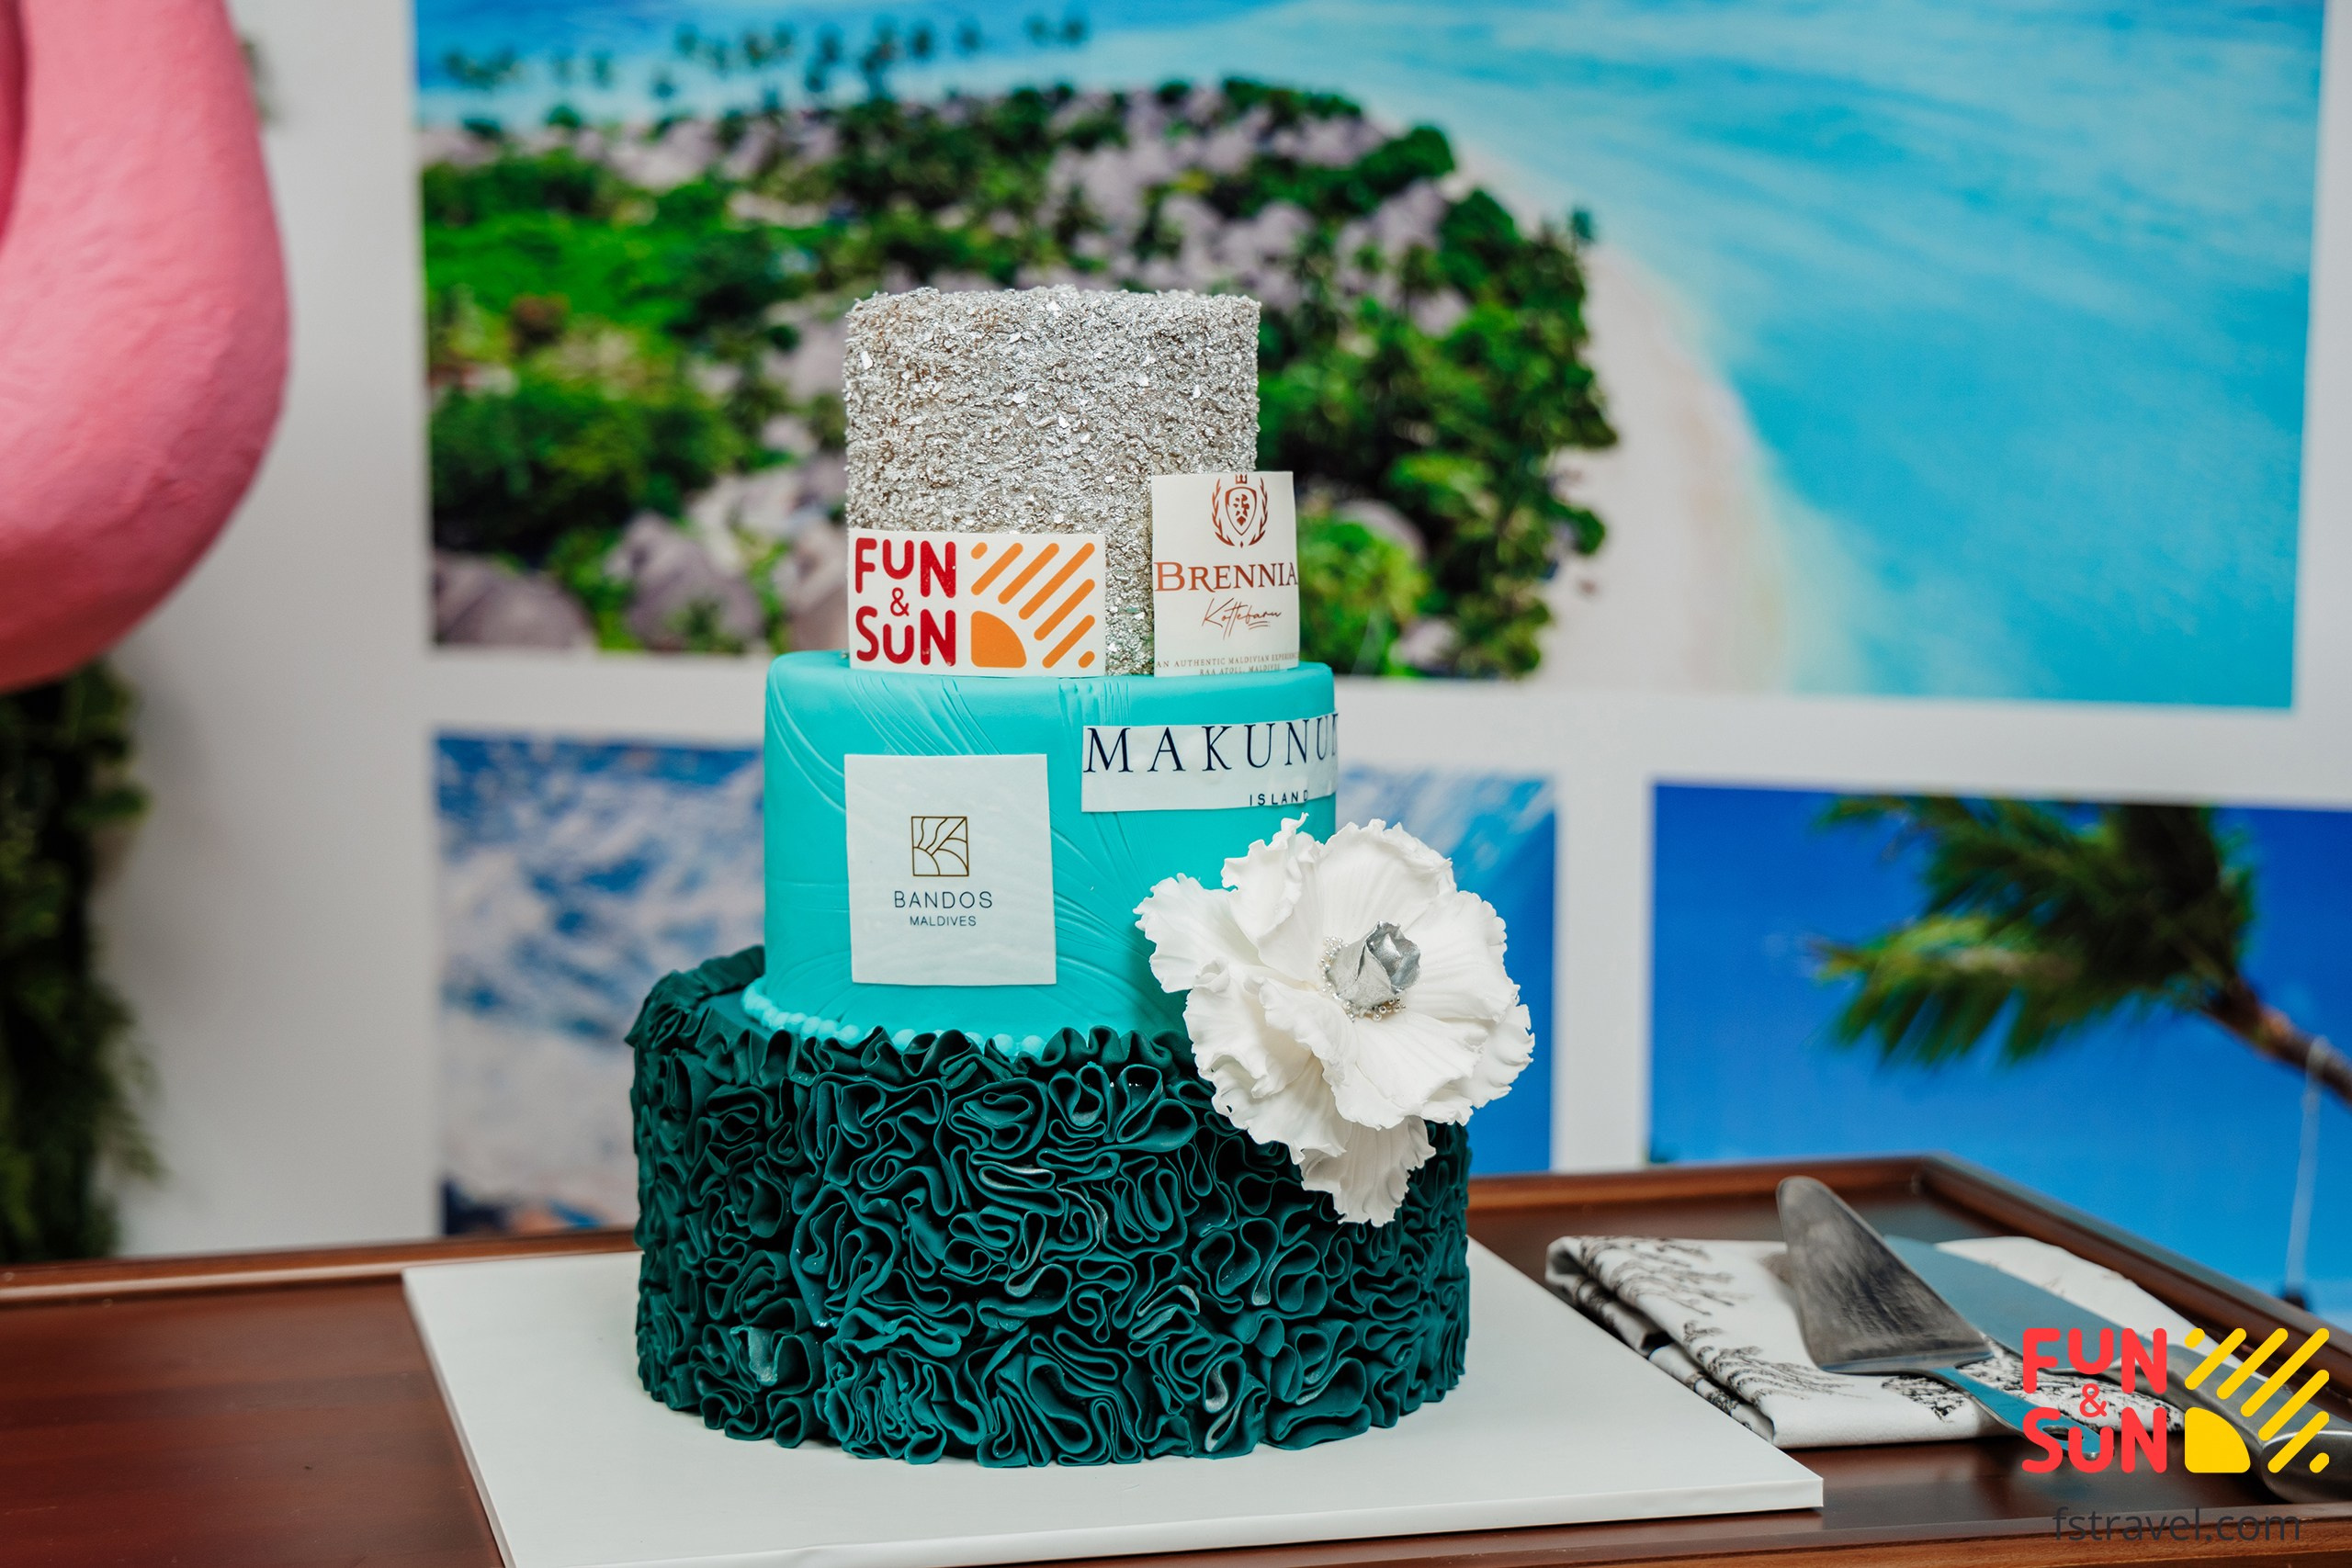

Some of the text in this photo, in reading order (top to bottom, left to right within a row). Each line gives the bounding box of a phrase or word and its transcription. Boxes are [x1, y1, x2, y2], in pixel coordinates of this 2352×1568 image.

[855, 537, 956, 599] FUN
[1154, 561, 1298, 593] BRENNIA
[890, 587, 910, 617] &
[855, 605, 956, 667] SUN
[1156, 660, 1170, 668] AN
[1174, 657, 1226, 668] AUTHENTIC
[1250, 789, 1309, 807] ISLAND
[894, 890, 993, 908] BANDOS
[910, 916, 977, 927] MALDIVES
